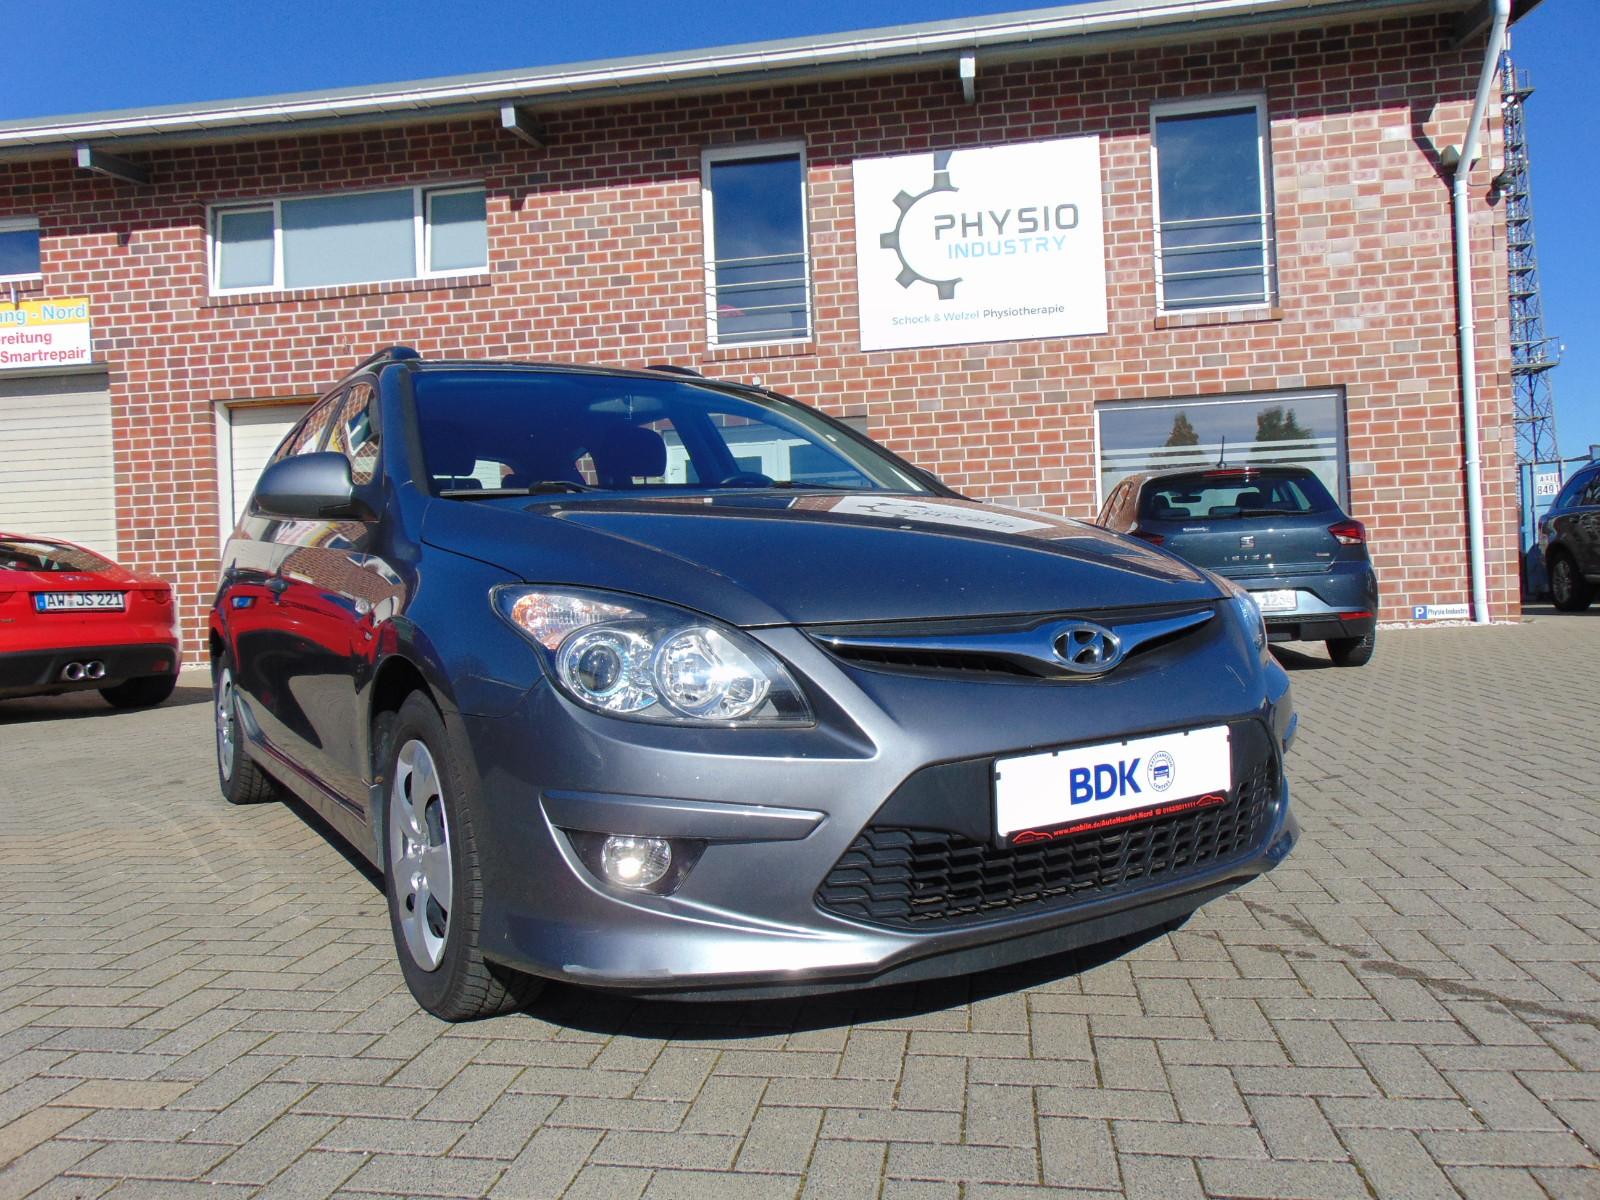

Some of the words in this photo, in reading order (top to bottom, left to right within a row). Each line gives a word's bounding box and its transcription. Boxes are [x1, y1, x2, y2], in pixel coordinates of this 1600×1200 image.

[933, 203, 1079, 240] PHYSIO
[948, 235, 1067, 259] INDUSTRY
[42, 304, 86, 320] Nord
[891, 314, 931, 326] Schock
[943, 310, 980, 321] Welzel
[982, 304, 1066, 320] Physiotherapie
[1, 332, 52, 345] reitung
[0, 347, 87, 363] Smartrepair
[47, 593, 65, 606] AW
[76, 594, 93, 606] JS
[98, 593, 122, 606] 221
[1070, 758, 1142, 805] BDK
